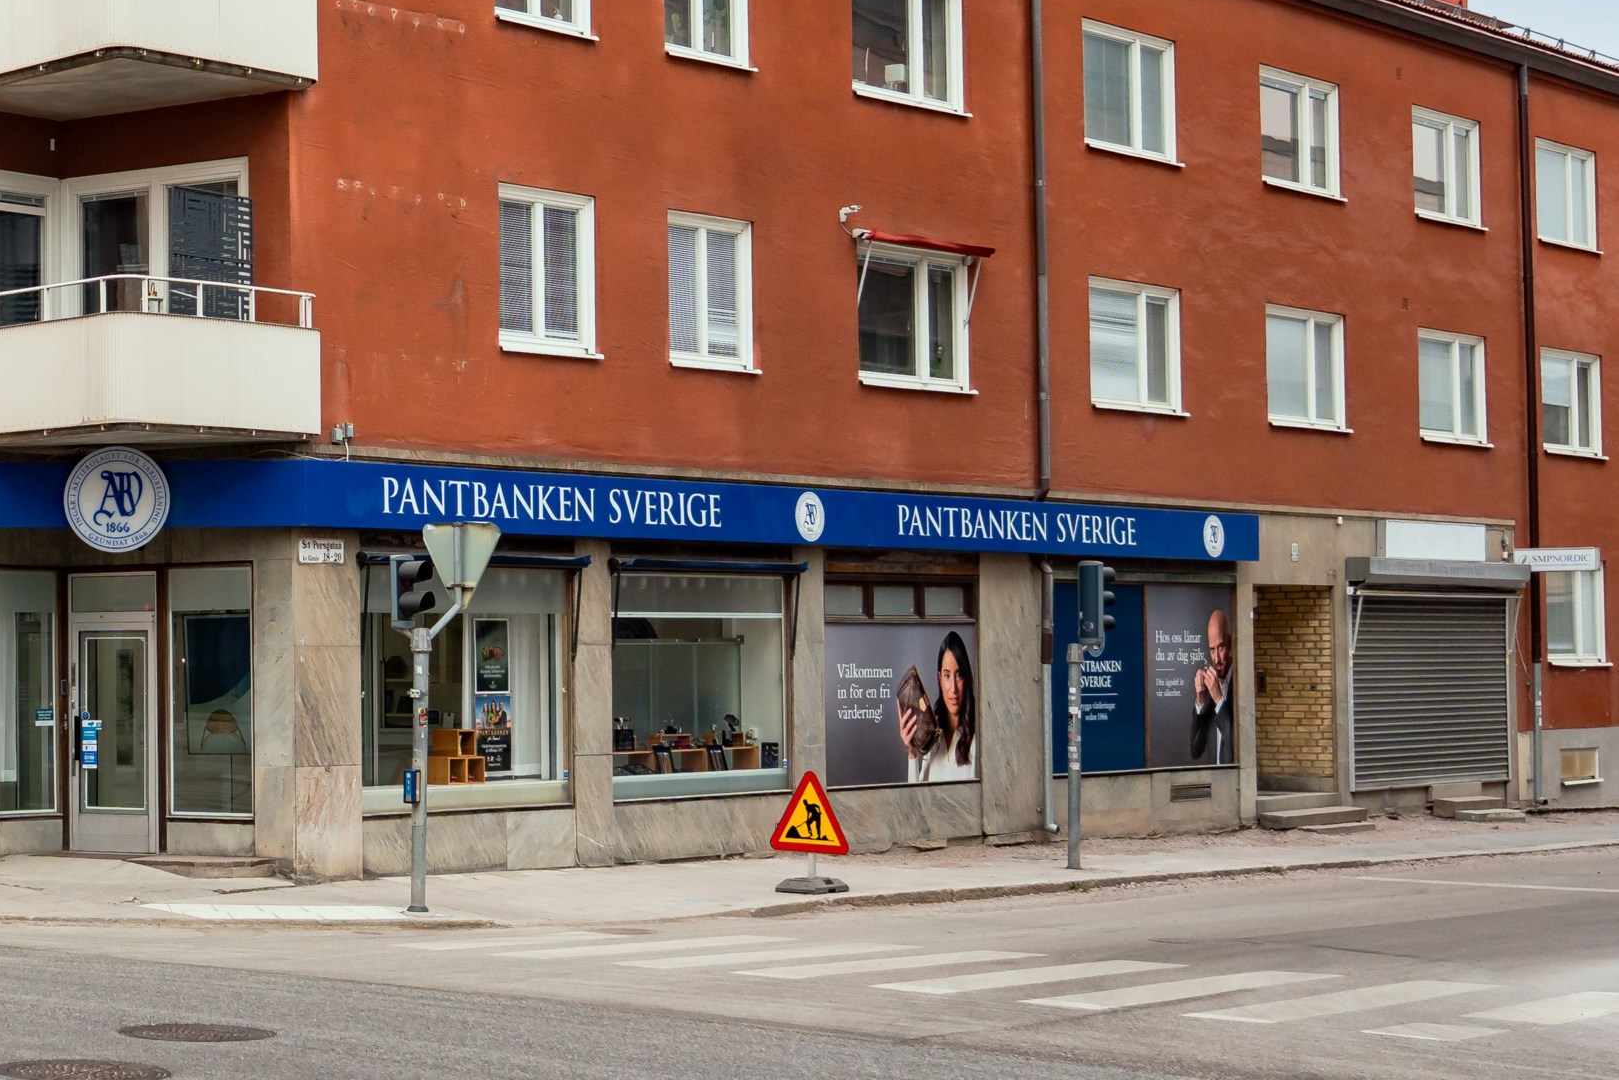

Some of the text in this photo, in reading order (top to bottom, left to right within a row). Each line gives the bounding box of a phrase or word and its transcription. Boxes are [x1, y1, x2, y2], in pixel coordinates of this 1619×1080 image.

[73, 453, 120, 492] AKTIEBOLAGET
[381, 476, 722, 527] PANTBANKEN SVERIGE
[106, 522, 130, 533] 1866
[897, 505, 1137, 546] PANTBANKEN SVERIGE
[88, 531, 148, 546] GRUNDAT 1866
[1532, 554, 1590, 563] SMPNORDIC
[1155, 630, 1201, 643] Hos oss lånar
[1155, 648, 1165, 661] du
[1167, 652, 1175, 661] av
[1176, 648, 1188, 665] dig
[837, 663, 893, 678] Välkommen
[1080, 660, 1122, 672] NTBANKEN
[1080, 676, 1112, 688] SVERIGE
[837, 683, 891, 699] in för en fri
[837, 704, 883, 723] värdering!
